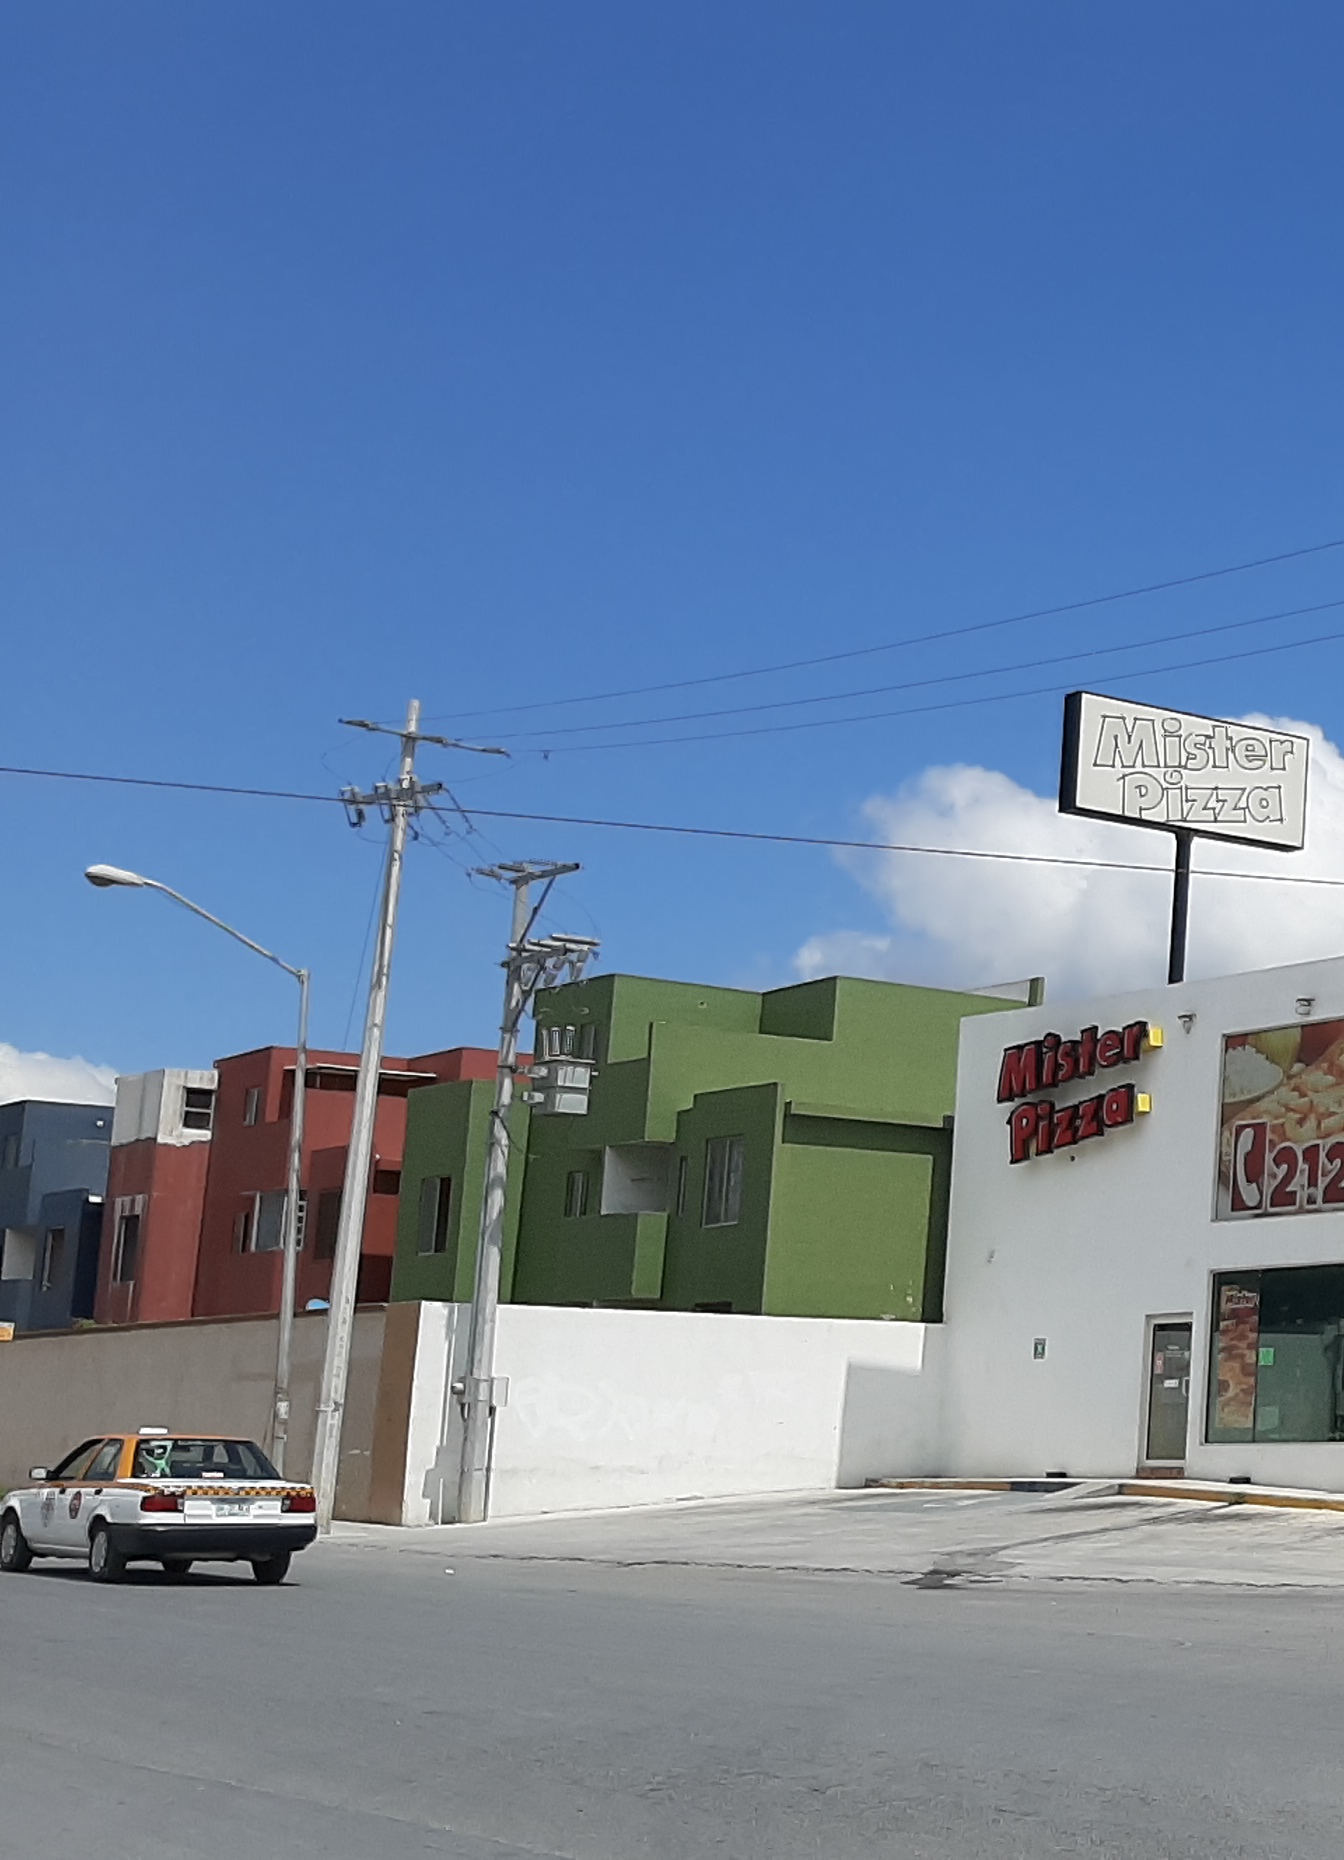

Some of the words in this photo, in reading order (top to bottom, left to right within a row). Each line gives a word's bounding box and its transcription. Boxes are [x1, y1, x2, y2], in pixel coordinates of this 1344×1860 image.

[1093, 714, 1295, 771] Mister
[1116, 770, 1286, 824] Pizza
[997, 1020, 1148, 1104] Mister
[1006, 1083, 1135, 1164] Pizza
